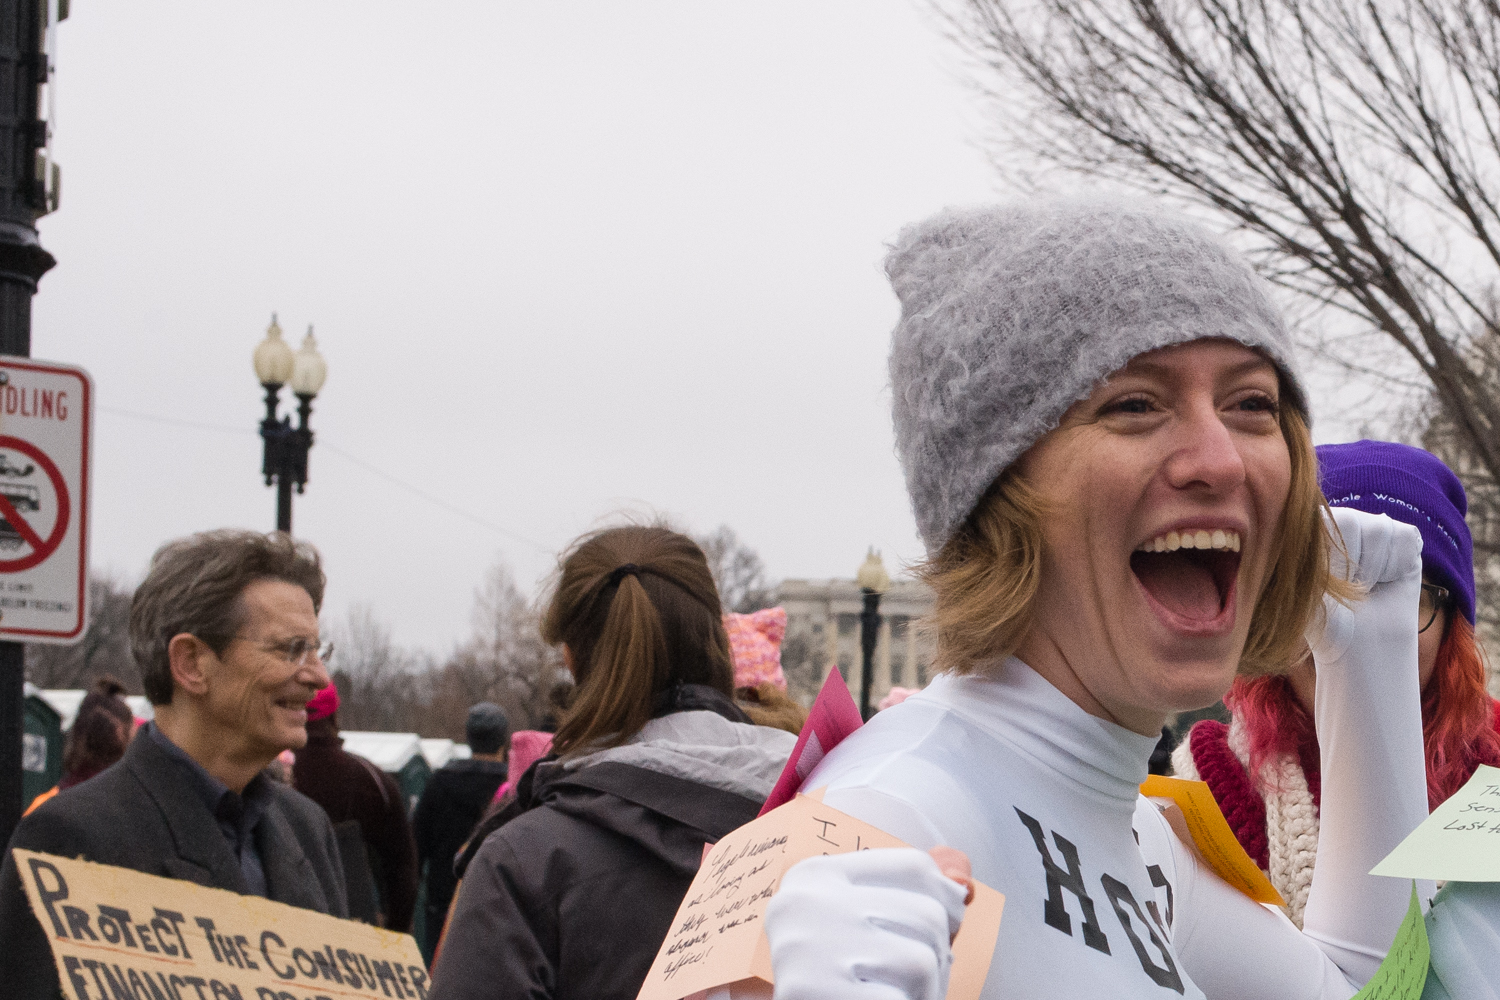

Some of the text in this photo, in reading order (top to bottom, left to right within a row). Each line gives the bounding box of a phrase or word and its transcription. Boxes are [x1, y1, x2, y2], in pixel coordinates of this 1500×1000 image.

[812, 816, 840, 847] I
[27, 857, 192, 960] PROTECT
[194, 915, 260, 971] THE
